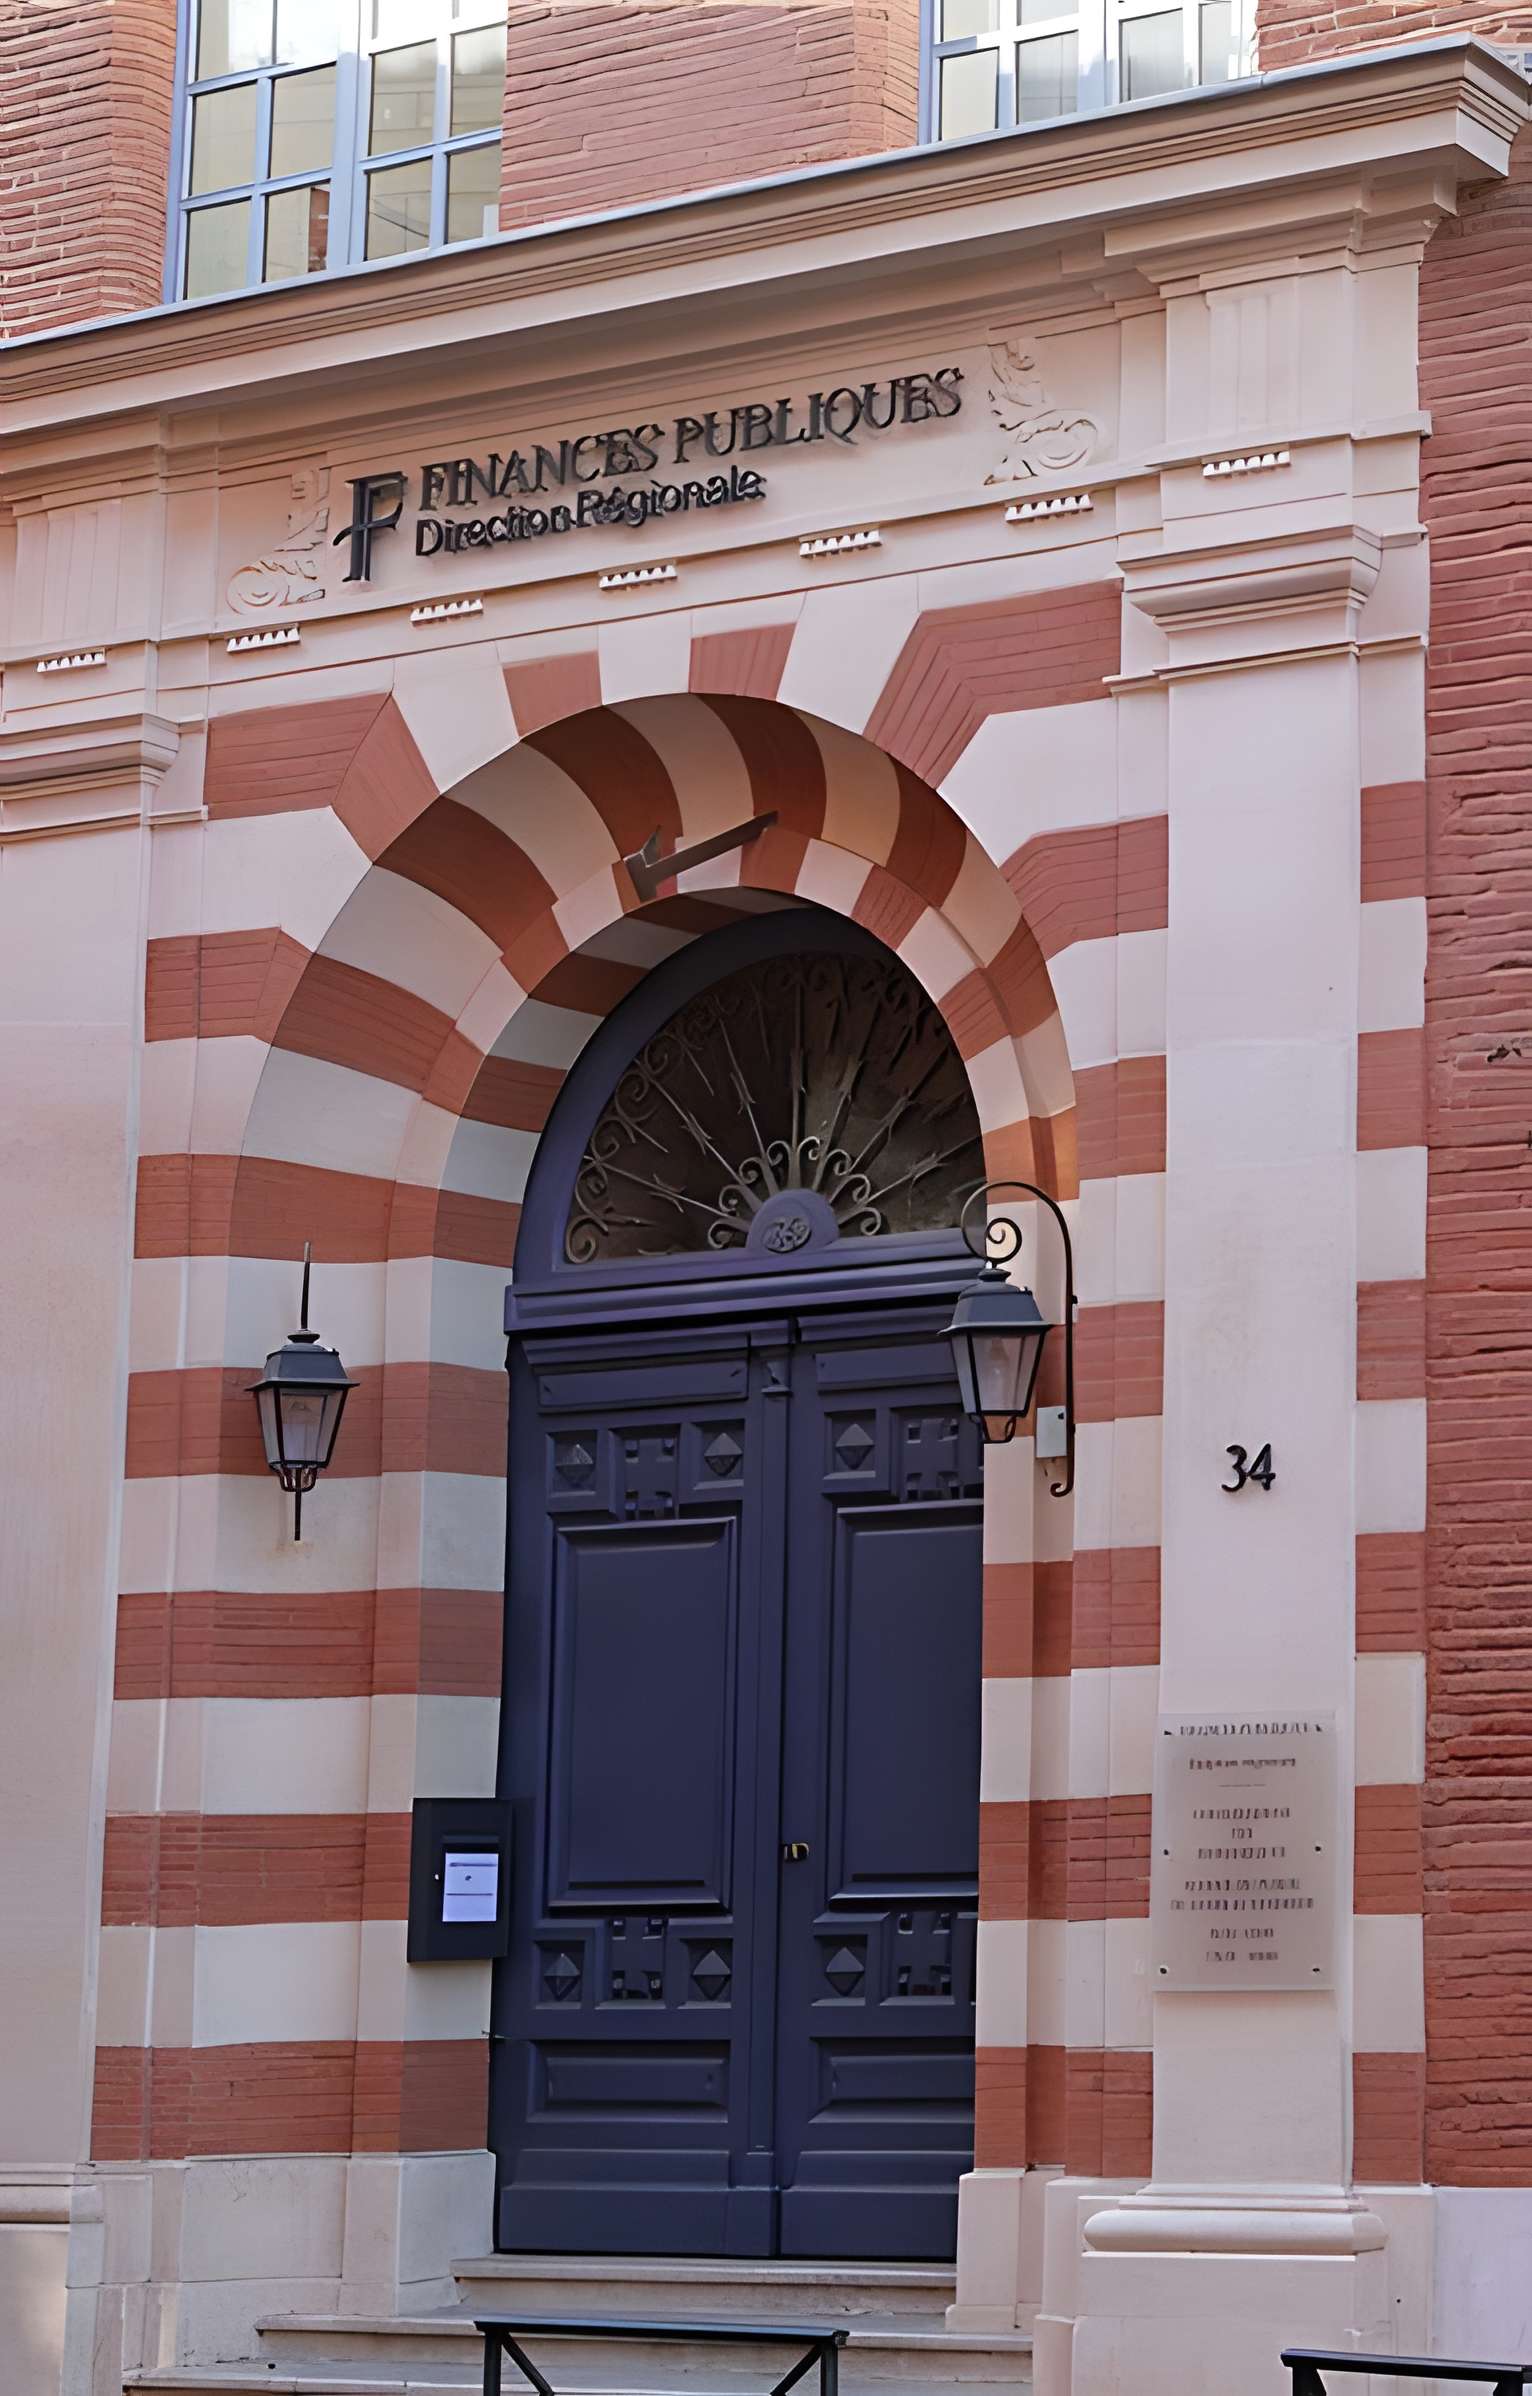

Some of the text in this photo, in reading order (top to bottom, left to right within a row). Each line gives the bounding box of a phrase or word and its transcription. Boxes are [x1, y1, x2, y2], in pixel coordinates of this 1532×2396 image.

[418, 367, 965, 511] FINANCES PUBLIQUES
[415, 504, 572, 556] Direction
[1221, 1443, 1276, 1492] 34
